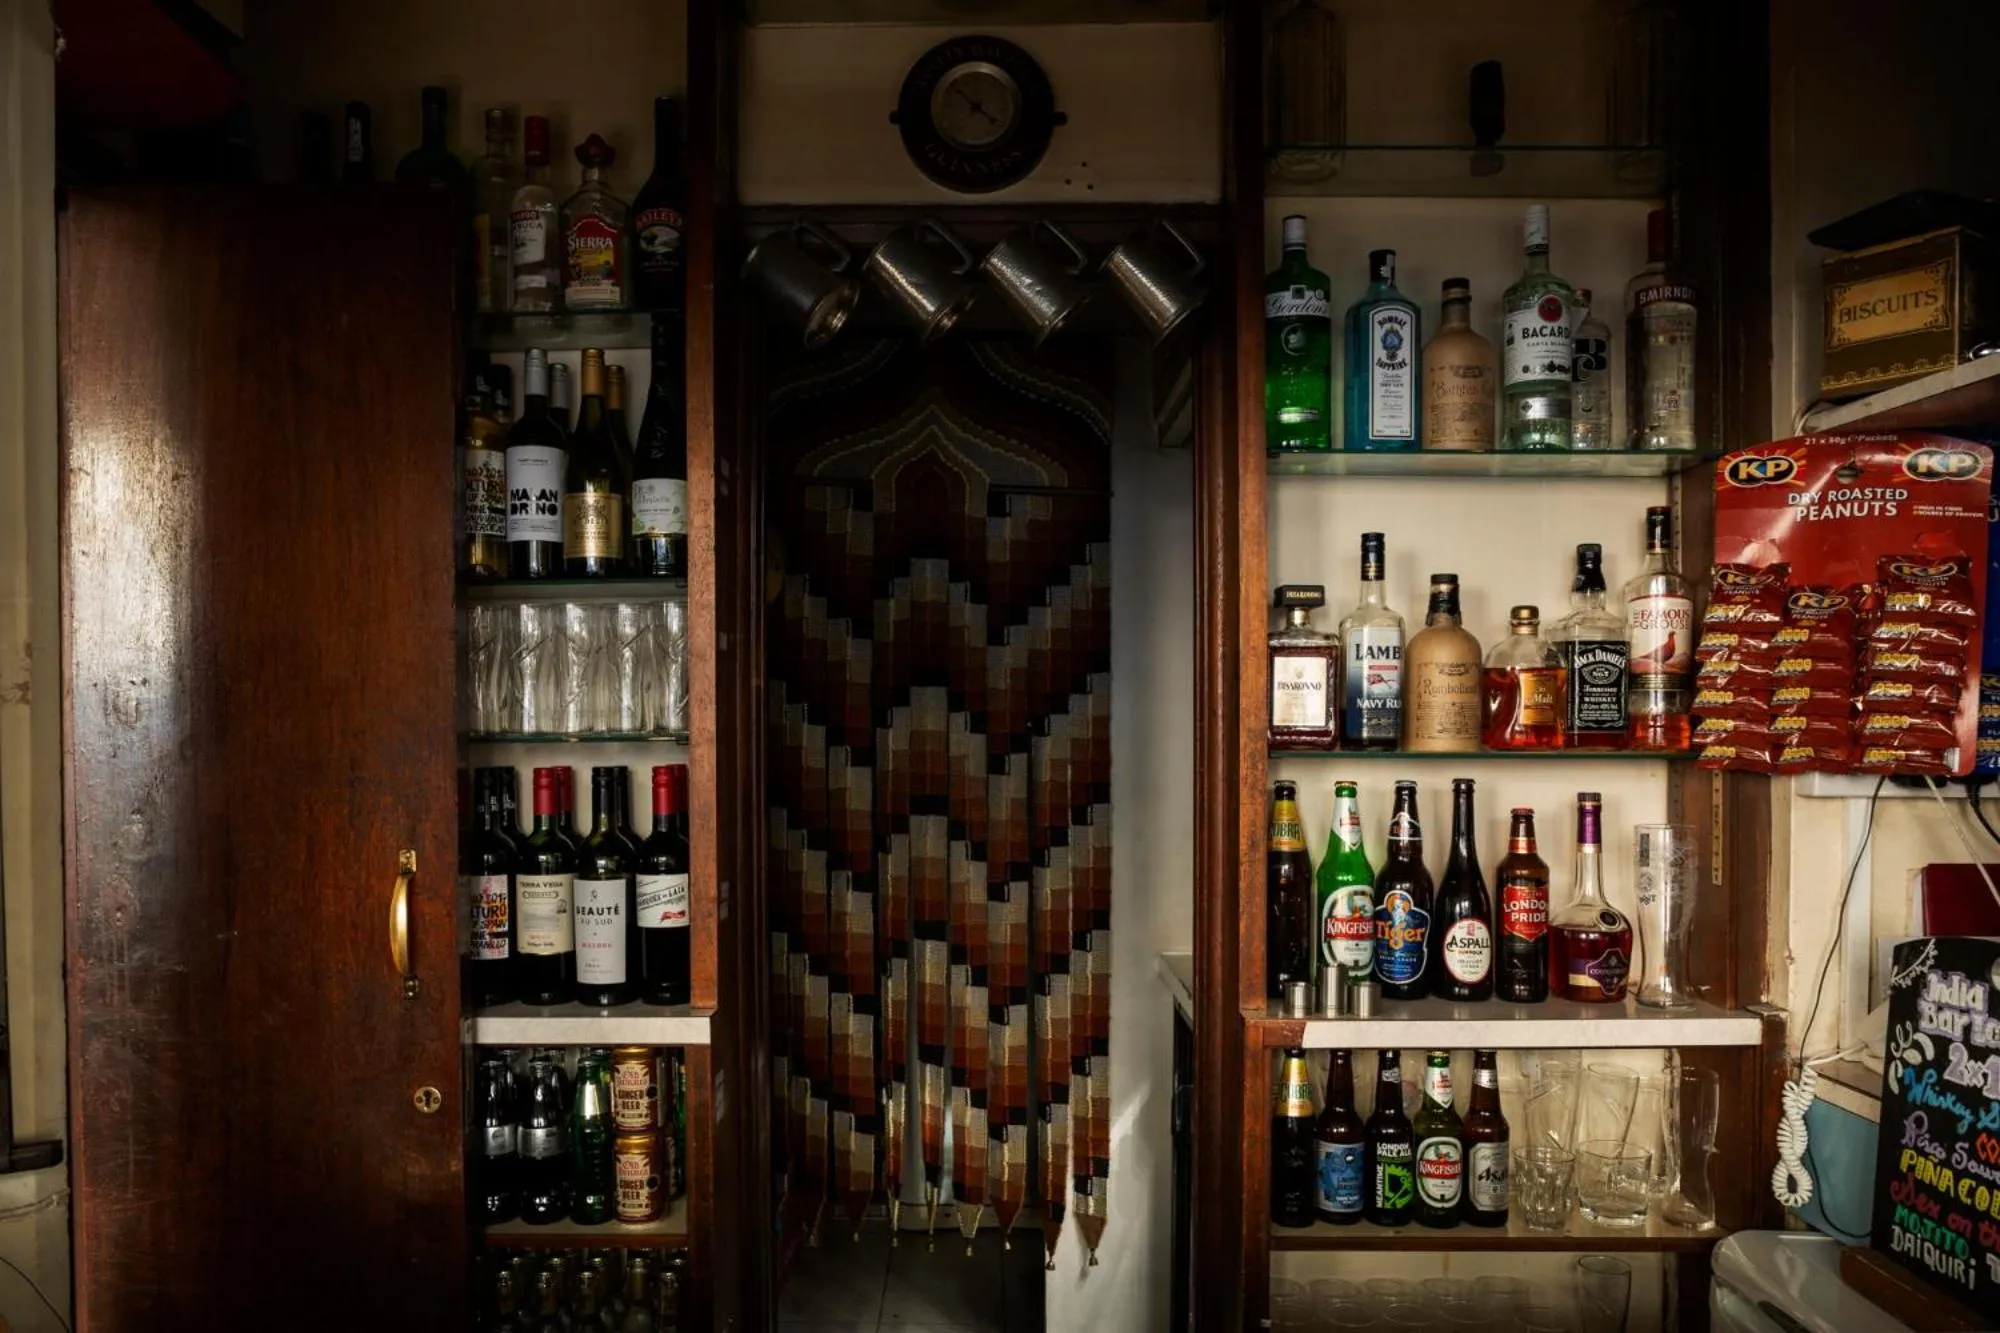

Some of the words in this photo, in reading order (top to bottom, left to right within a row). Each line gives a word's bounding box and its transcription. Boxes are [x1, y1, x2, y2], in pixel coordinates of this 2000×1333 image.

[567, 236, 615, 250] SIERRA
[1838, 288, 1939, 325] BISCUITS
[1376, 314, 1408, 329] BOMBAY
[1375, 358, 1408, 371] SAPPHIRE
[1738, 460, 1790, 480] KP
[1916, 453, 1976, 475] KP
[1788, 491, 1821, 506] DRY
[1827, 488, 1909, 503] ROASTED
[1796, 500, 1898, 522] PEANUTS
[1639, 619, 1689, 630] GROUSE
[1573, 651, 1595, 669] JACK
[1277, 681, 1323, 692] DISARONNO
[1356, 698, 1385, 709] NAVY
[1386, 697, 1402, 709] RU
[576, 904, 621, 916] BEAUTÉ
[1503, 899, 1549, 912] LONDO
[1326, 917, 1374, 936] KINGFISH
[1511, 912, 1547, 923] PRIDE
[1376, 919, 1426, 951] Tiger
[1447, 935, 1491, 953] ASPALL
[1918, 999, 1969, 1041] Bar
[1943, 1042, 2000, 1099] 2x1
[618, 1089, 645, 1099] GINGER
[1903, 1065, 1975, 1136] Whiskey
[622, 1100, 641, 1110] BEER
[1901, 1110, 1947, 1162] Pisco
[1376, 1141, 1409, 1150] LONDON
[1376, 1149, 1398, 1157] PALE
[619, 1179, 645, 1189] GINGER
[1375, 1162, 1384, 1209] MEANTIME
[1900, 1147, 1955, 1199] PIÑA
[1957, 1177, 2000, 1221] COL
[622, 1190, 641, 1201] BEER
[1890, 1171, 1942, 1219] Sex
[1946, 1211, 1975, 1240] on
[1893, 1203, 1971, 1261] MOJITO
